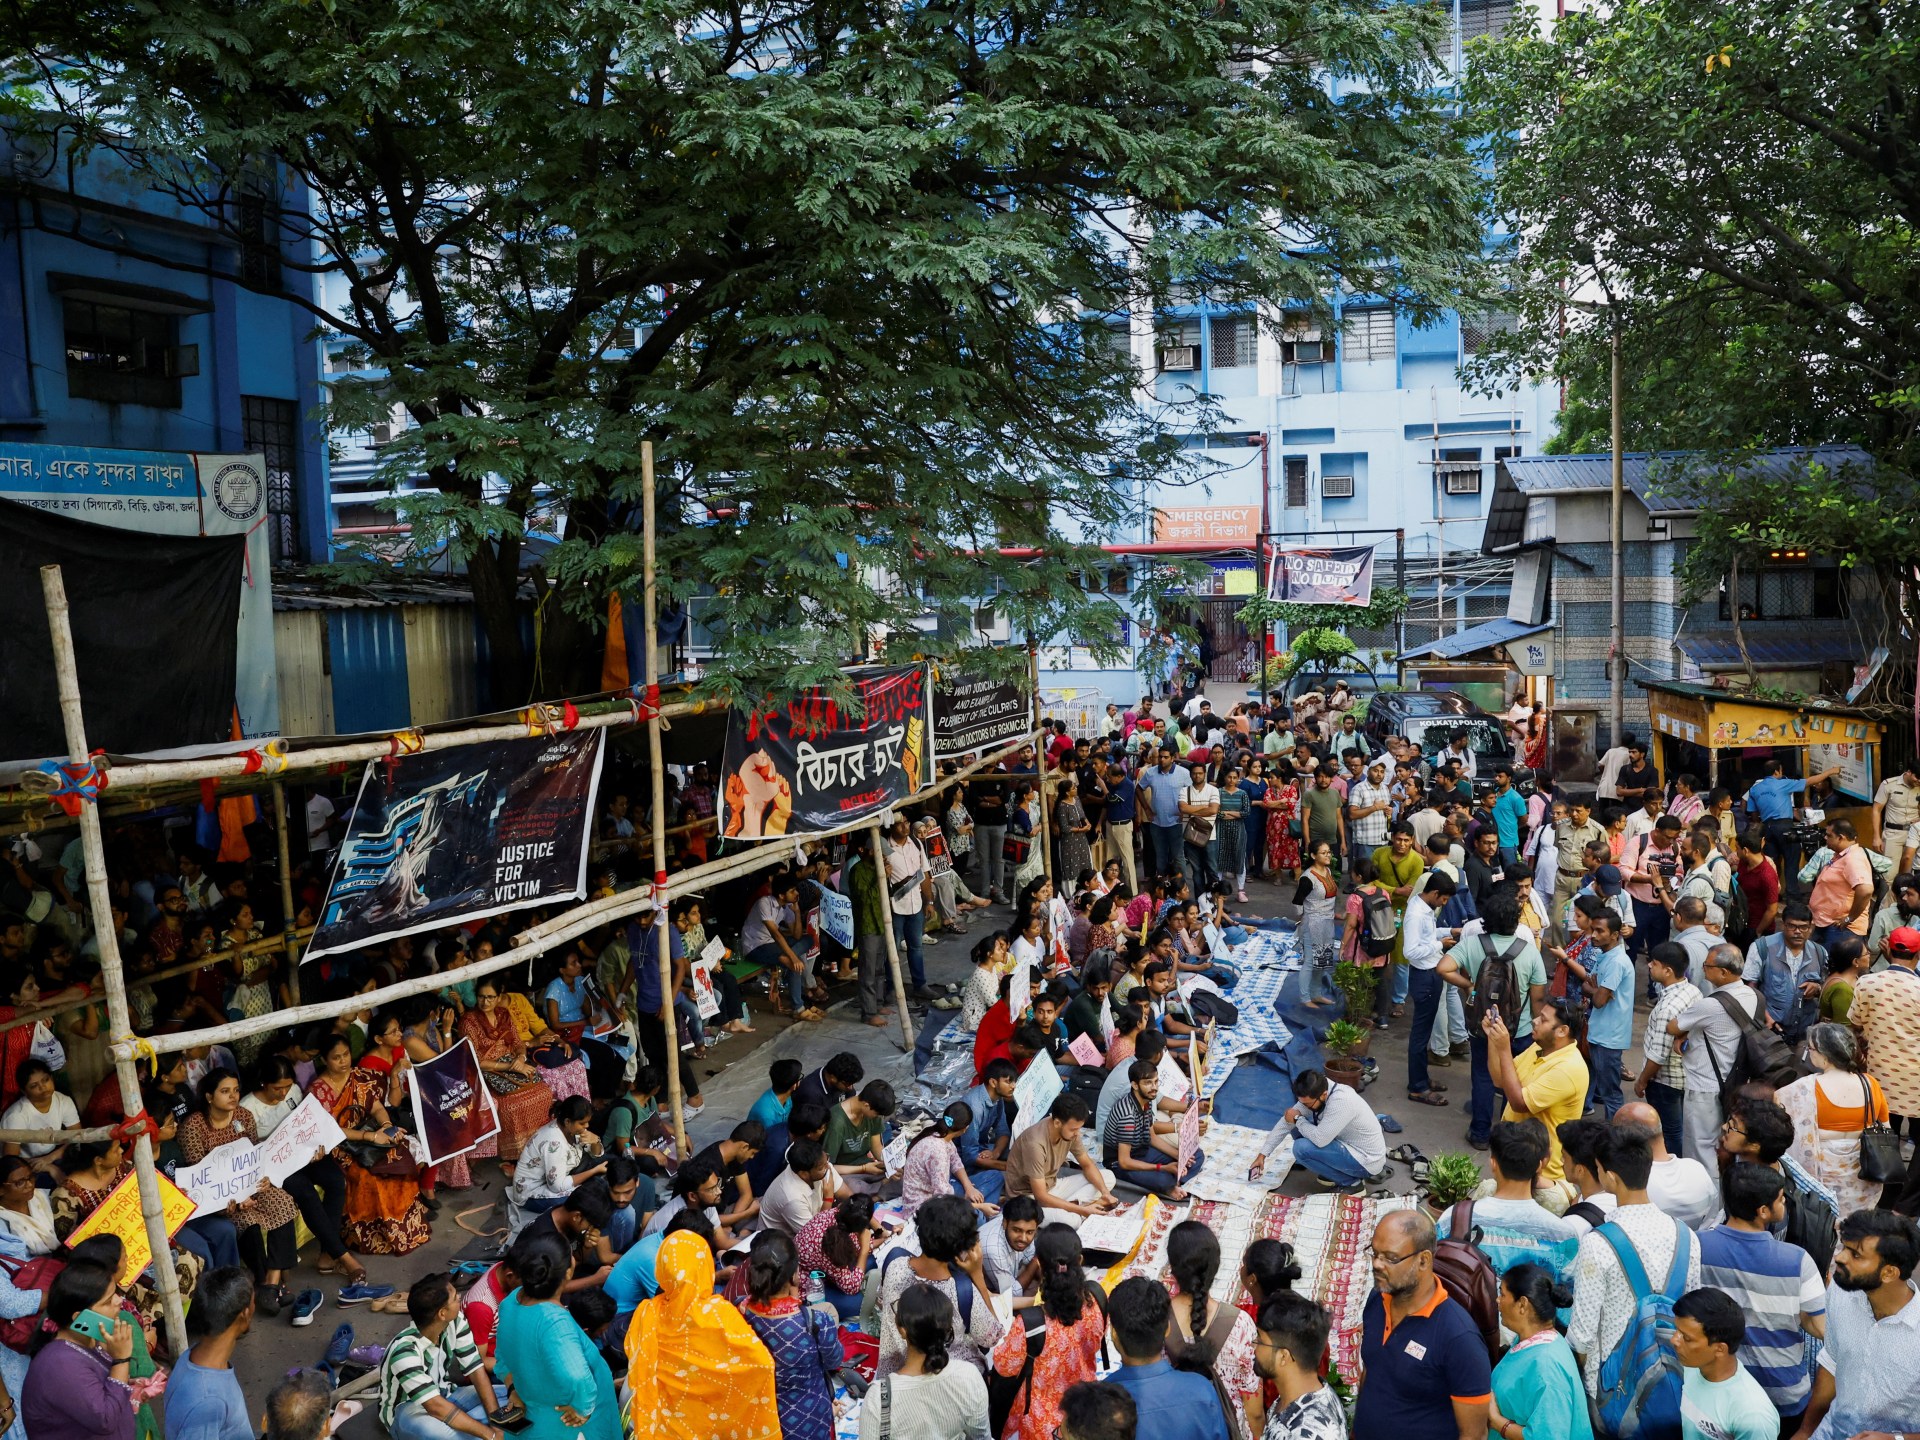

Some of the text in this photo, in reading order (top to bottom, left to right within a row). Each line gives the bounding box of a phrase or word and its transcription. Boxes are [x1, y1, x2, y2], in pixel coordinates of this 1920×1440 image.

[46, 460, 90, 479] একে
[93, 462, 136, 487] সুন্দর
[141, 464, 183, 489] রাখুন
[83, 497, 127, 513] (সিগারেট,
[153, 500, 179, 513] গুটকা,
[1167, 510, 1249, 522] EMERGENCY
[1168, 522, 1247, 537] জরুরী বিভাগ
[1285, 556, 1360, 574] NO SAFETY
[1292, 571, 1309, 584] NO
[954, 684, 971, 697] WANT
[973, 680, 996, 694] JUDICIAL
[953, 699, 969, 711] AND
[970, 711, 979, 721] OF
[1460, 719, 1488, 727] POLICE
[966, 729, 989, 746] DOCTORS
[989, 727, 998, 738] OF
[796, 723, 905, 796] বিচার চাই
[497, 841, 555, 863] JUSTICE
[496, 864, 522, 884] FOR
[495, 879, 541, 902] VICTIM
[191, 1145, 264, 1188] WE WANT
[210, 1167, 261, 1201] JUSTICE
[1698, 1421, 1718, 1439] adidas
